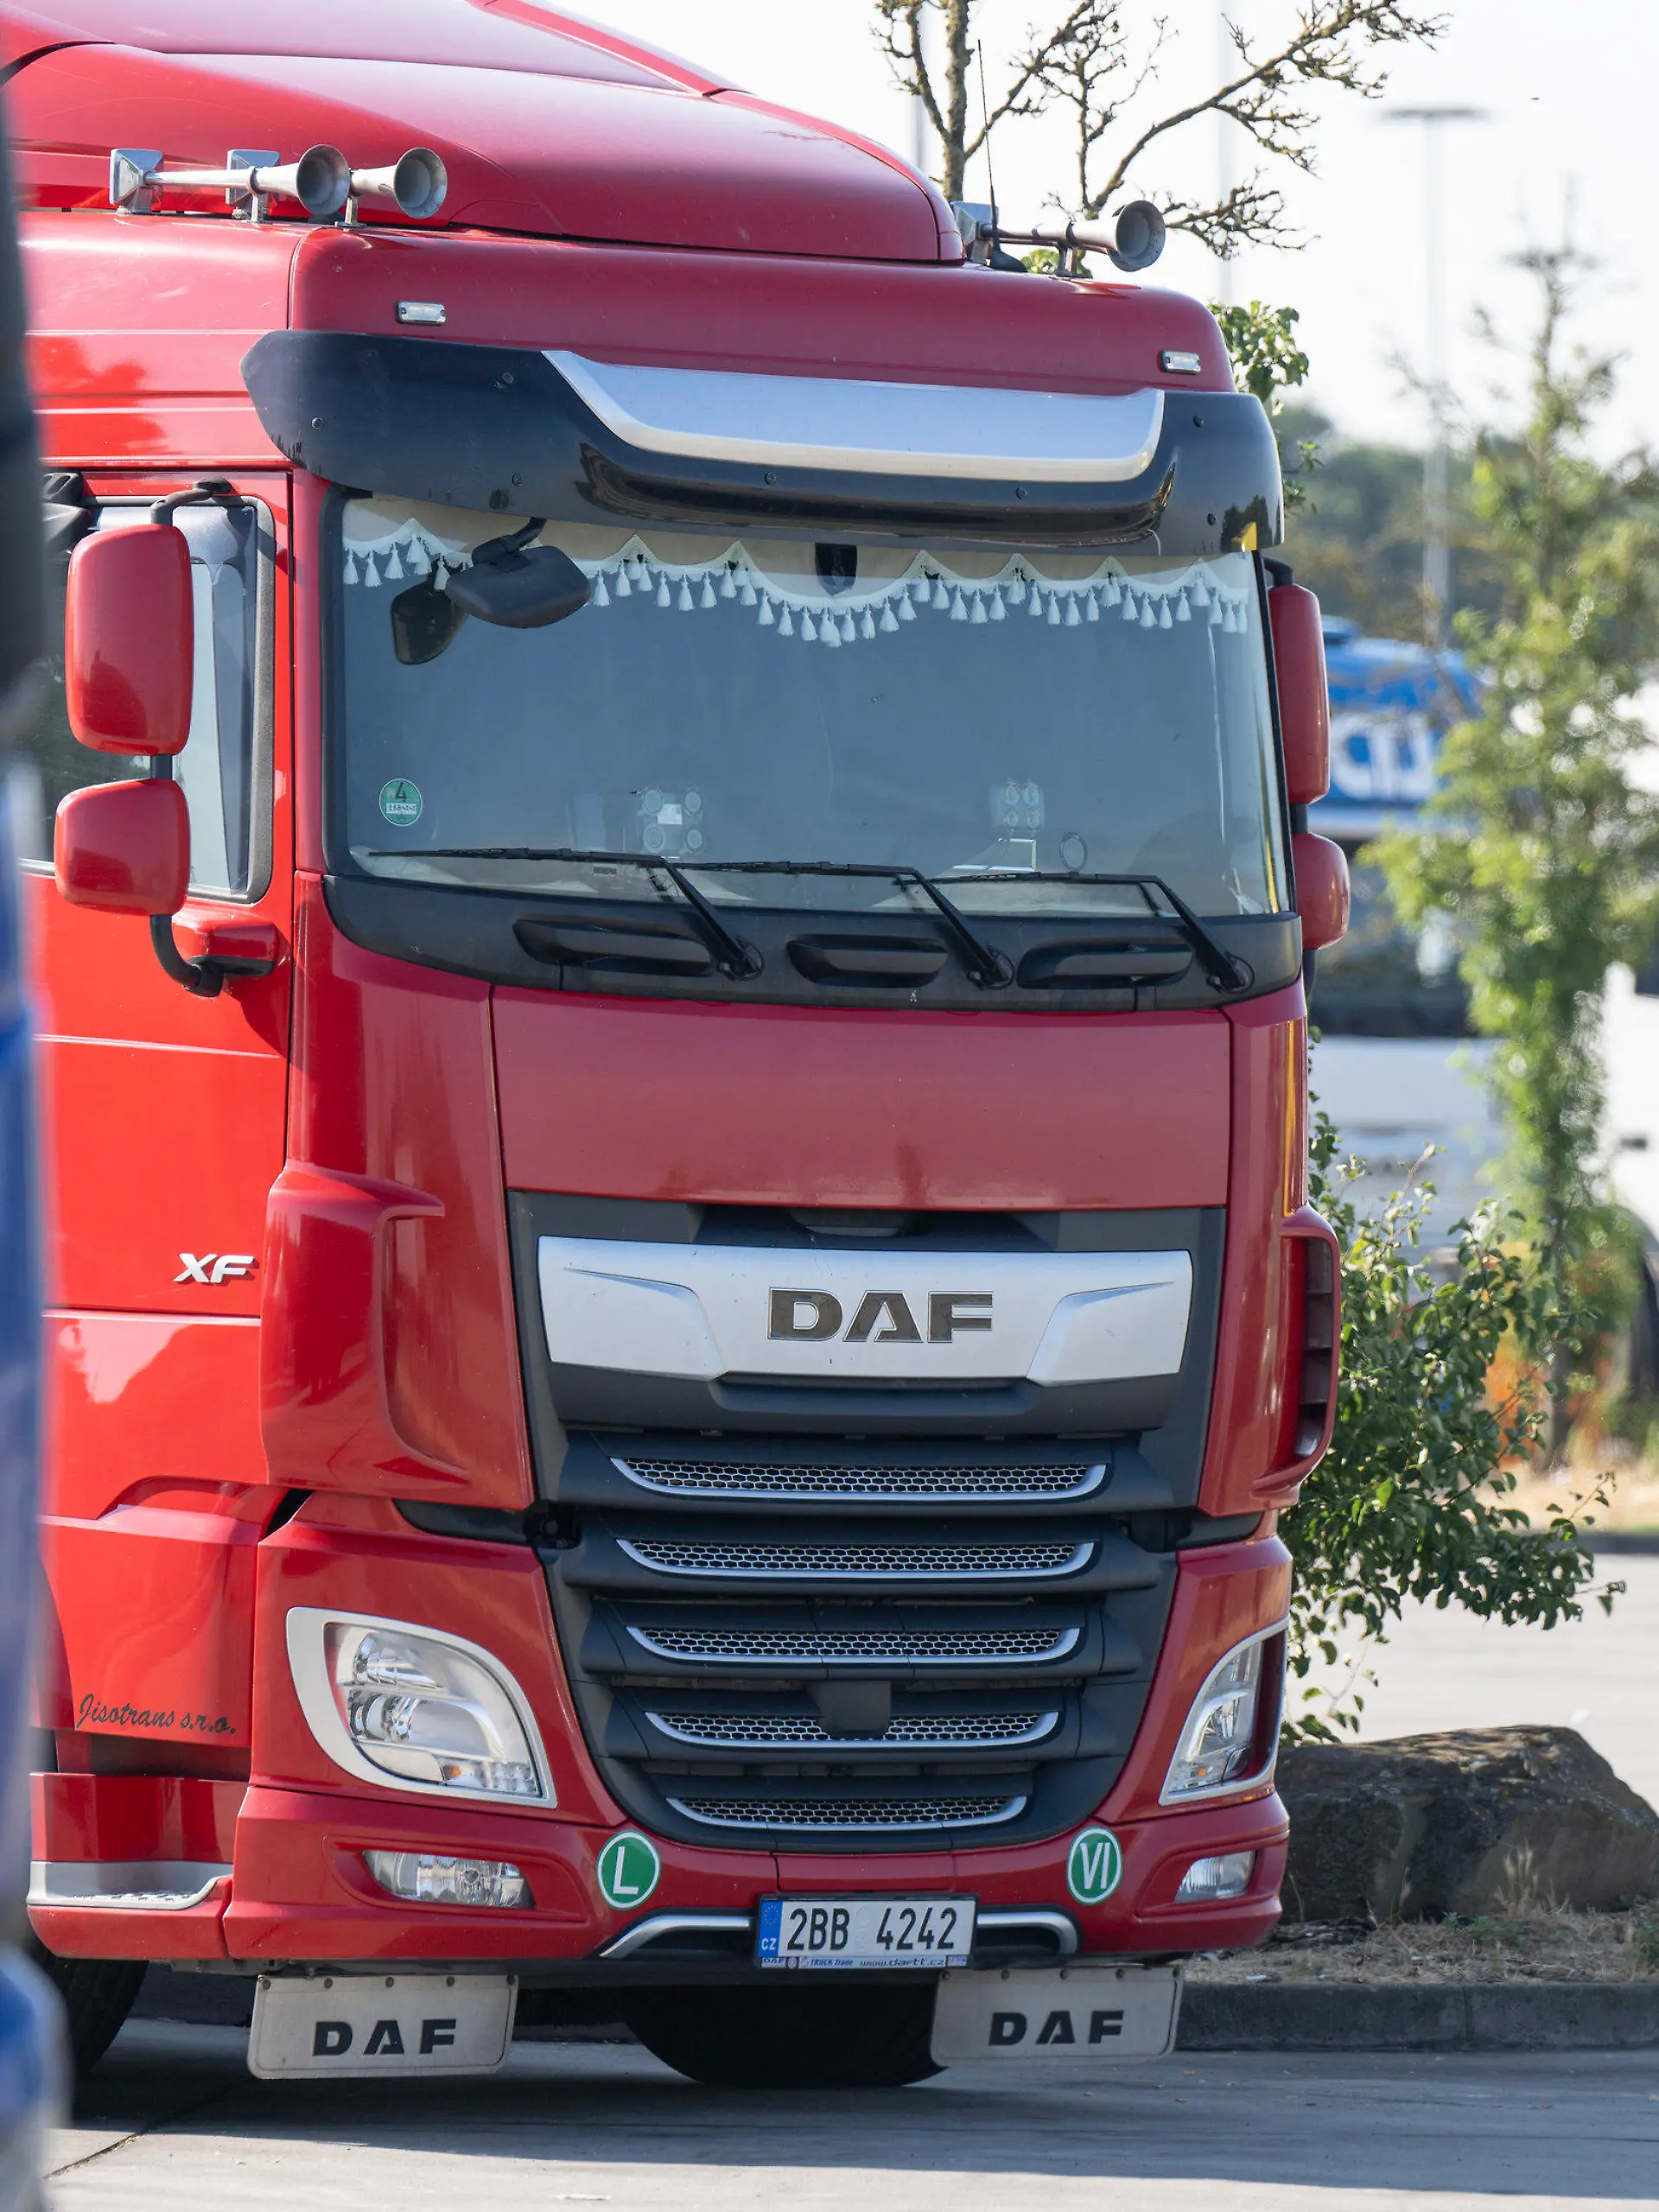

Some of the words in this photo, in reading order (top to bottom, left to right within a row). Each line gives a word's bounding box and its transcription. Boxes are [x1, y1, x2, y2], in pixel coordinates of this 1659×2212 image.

[395, 782, 407, 802] 4
[174, 1253, 254, 1283] XF
[767, 1287, 994, 1343] DAF
[76, 1693, 175, 1728] Jisotrans
[180, 1713, 237, 1734] s.r.o.
[613, 1847, 639, 1895] L
[1080, 1842, 1110, 1890] VI
[761, 1938, 777, 1951] CZ
[787, 1908, 850, 1951] 2BB
[876, 1907, 957, 1951] 4242
[313, 2018, 456, 2056] DAF
[988, 2010, 1125, 2046] DAF
